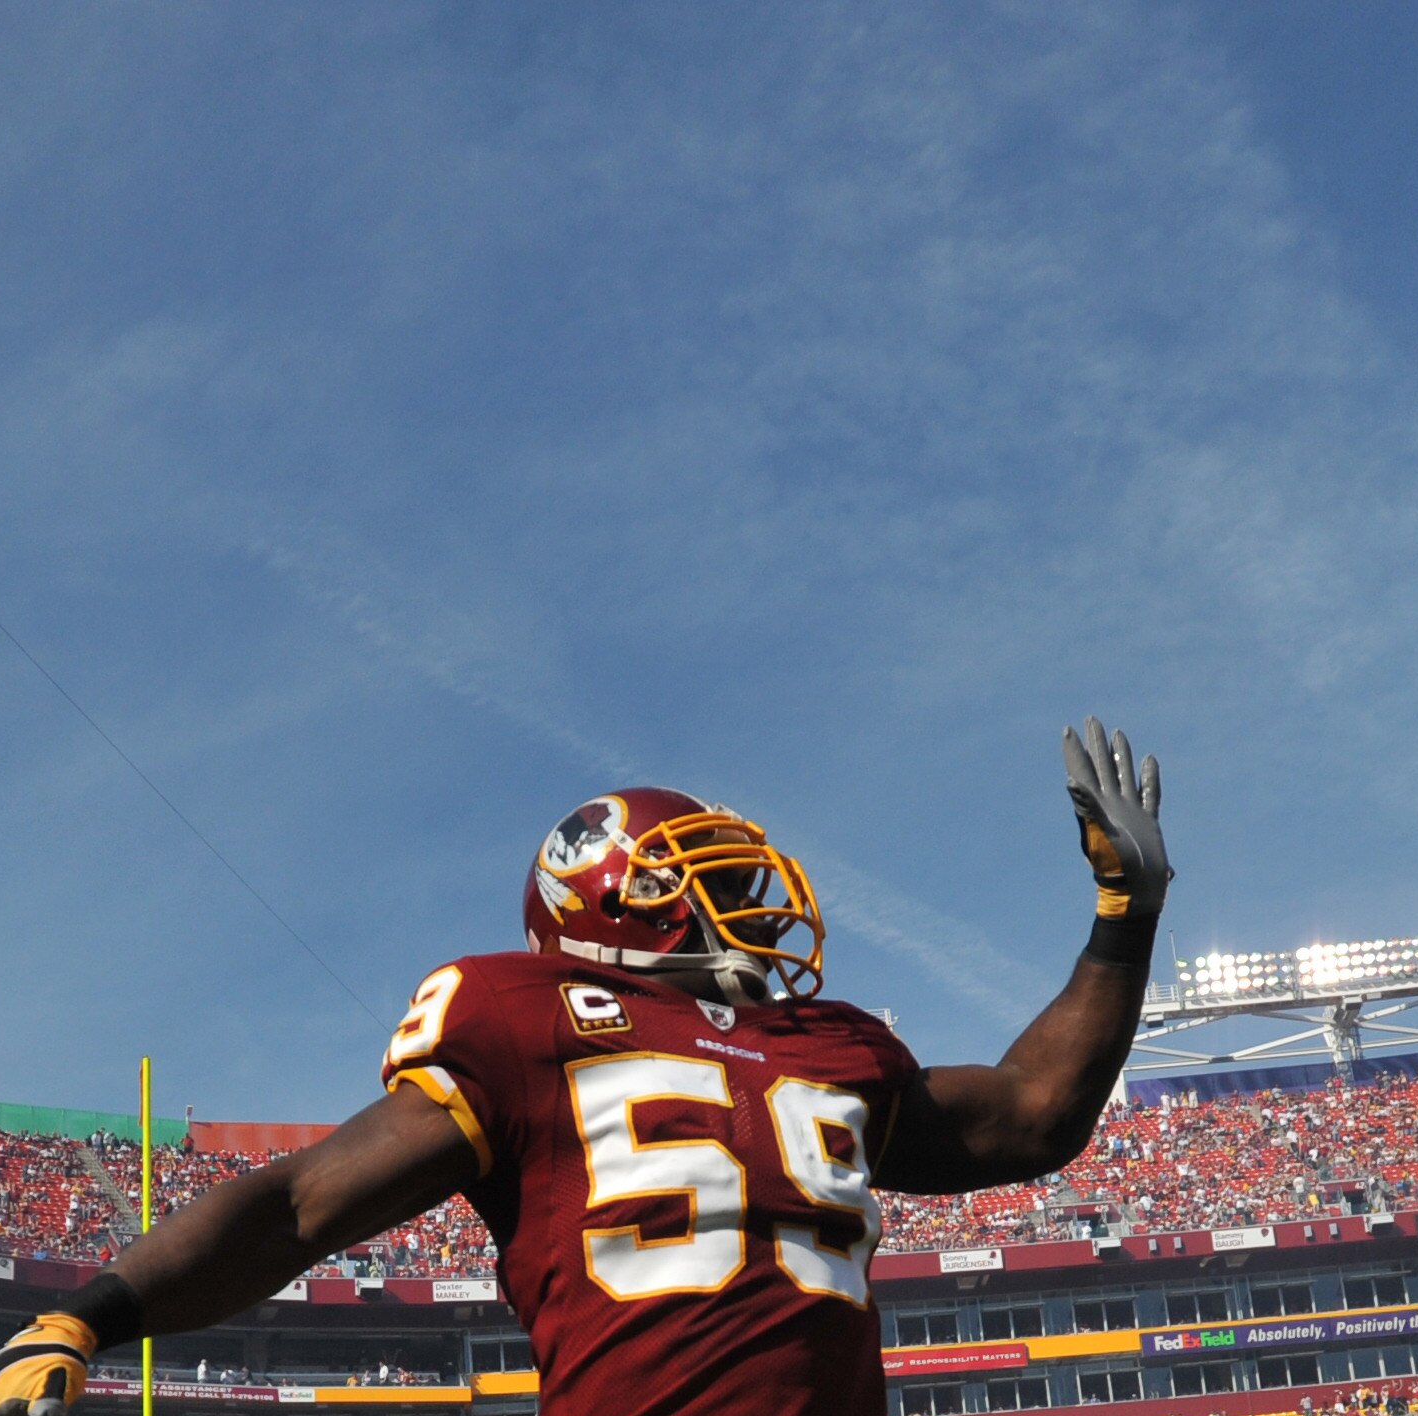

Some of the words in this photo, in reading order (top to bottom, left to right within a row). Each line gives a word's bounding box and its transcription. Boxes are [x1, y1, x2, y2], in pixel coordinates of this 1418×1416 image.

[564, 984, 623, 1022] C
[564, 1050, 881, 1311] 59
[943, 1254, 967, 1262] Sonny
[944, 1260, 994, 1270] JURGENSEN
[435, 1282, 463, 1290] Dexter
[435, 1291, 470, 1299] MANLEY
[1247, 1323, 1326, 1343] Absolutely,
[1335, 1314, 1406, 1336] Positively
[1155, 1330, 1236, 1351] FedExField
[909, 1355, 980, 1366] RESPONSIBILITY
[983, 1352, 1022, 1361] MATTERS
